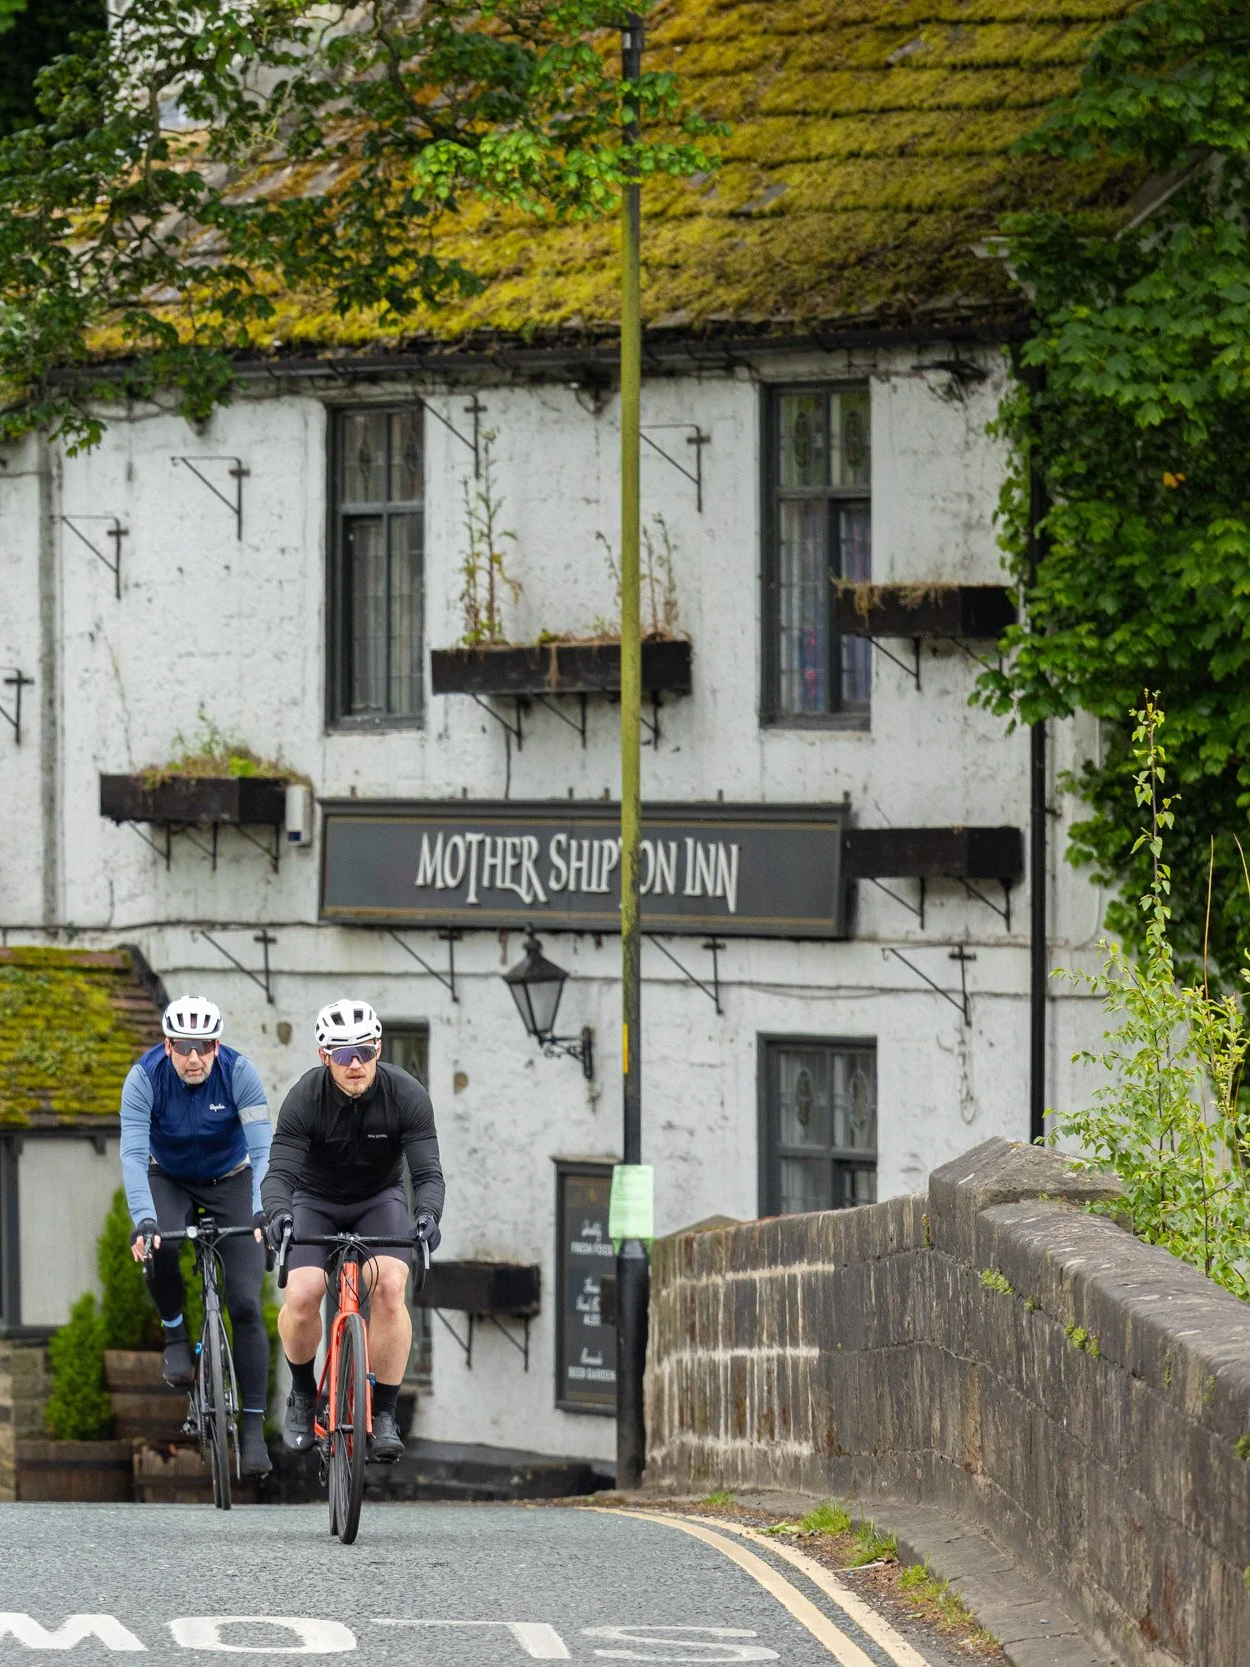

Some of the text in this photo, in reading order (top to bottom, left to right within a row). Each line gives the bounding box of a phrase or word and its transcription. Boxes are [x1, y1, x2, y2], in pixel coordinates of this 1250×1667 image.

[414, 831, 740, 914] MOTHER SHIPON INN
